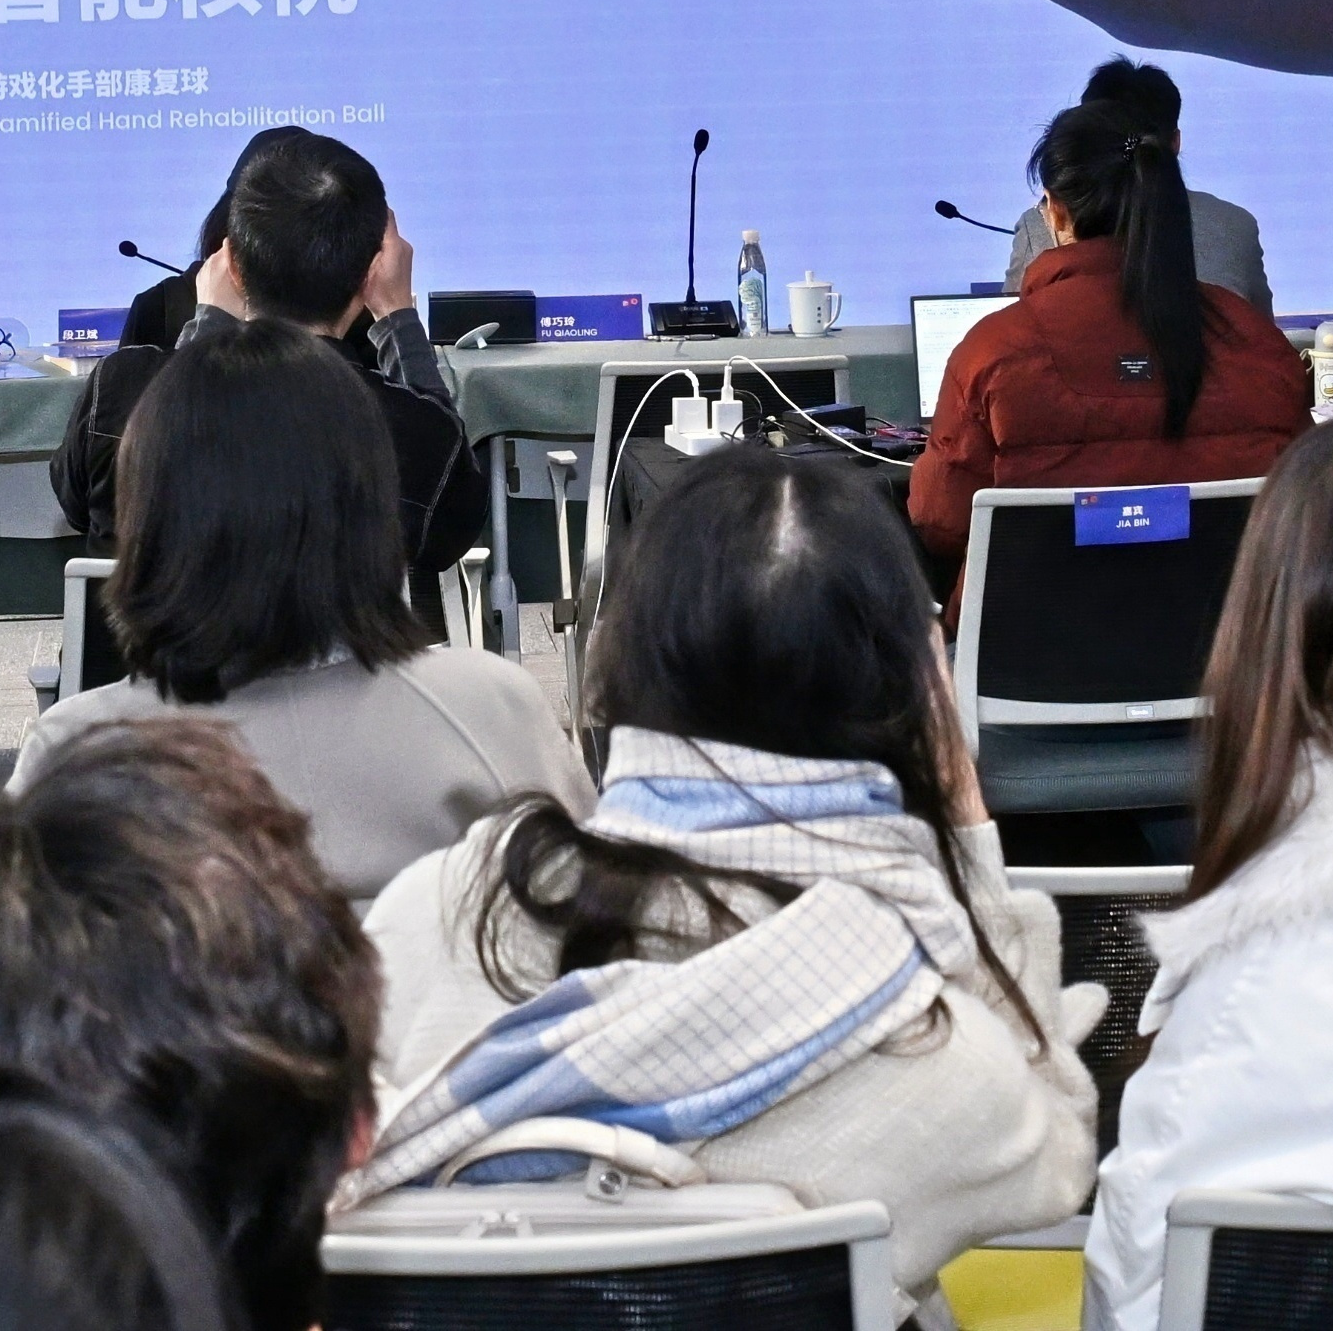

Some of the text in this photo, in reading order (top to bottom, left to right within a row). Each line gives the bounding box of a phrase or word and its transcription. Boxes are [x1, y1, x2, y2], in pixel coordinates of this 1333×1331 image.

[99, 110, 162, 131] Hand
[170, 105, 336, 129] Rehabilitation
[342, 103, 386, 124] Ball
[541, 328, 598, 337] FU QIAOLING
[1116, 517, 1150, 529] JIA BIN
